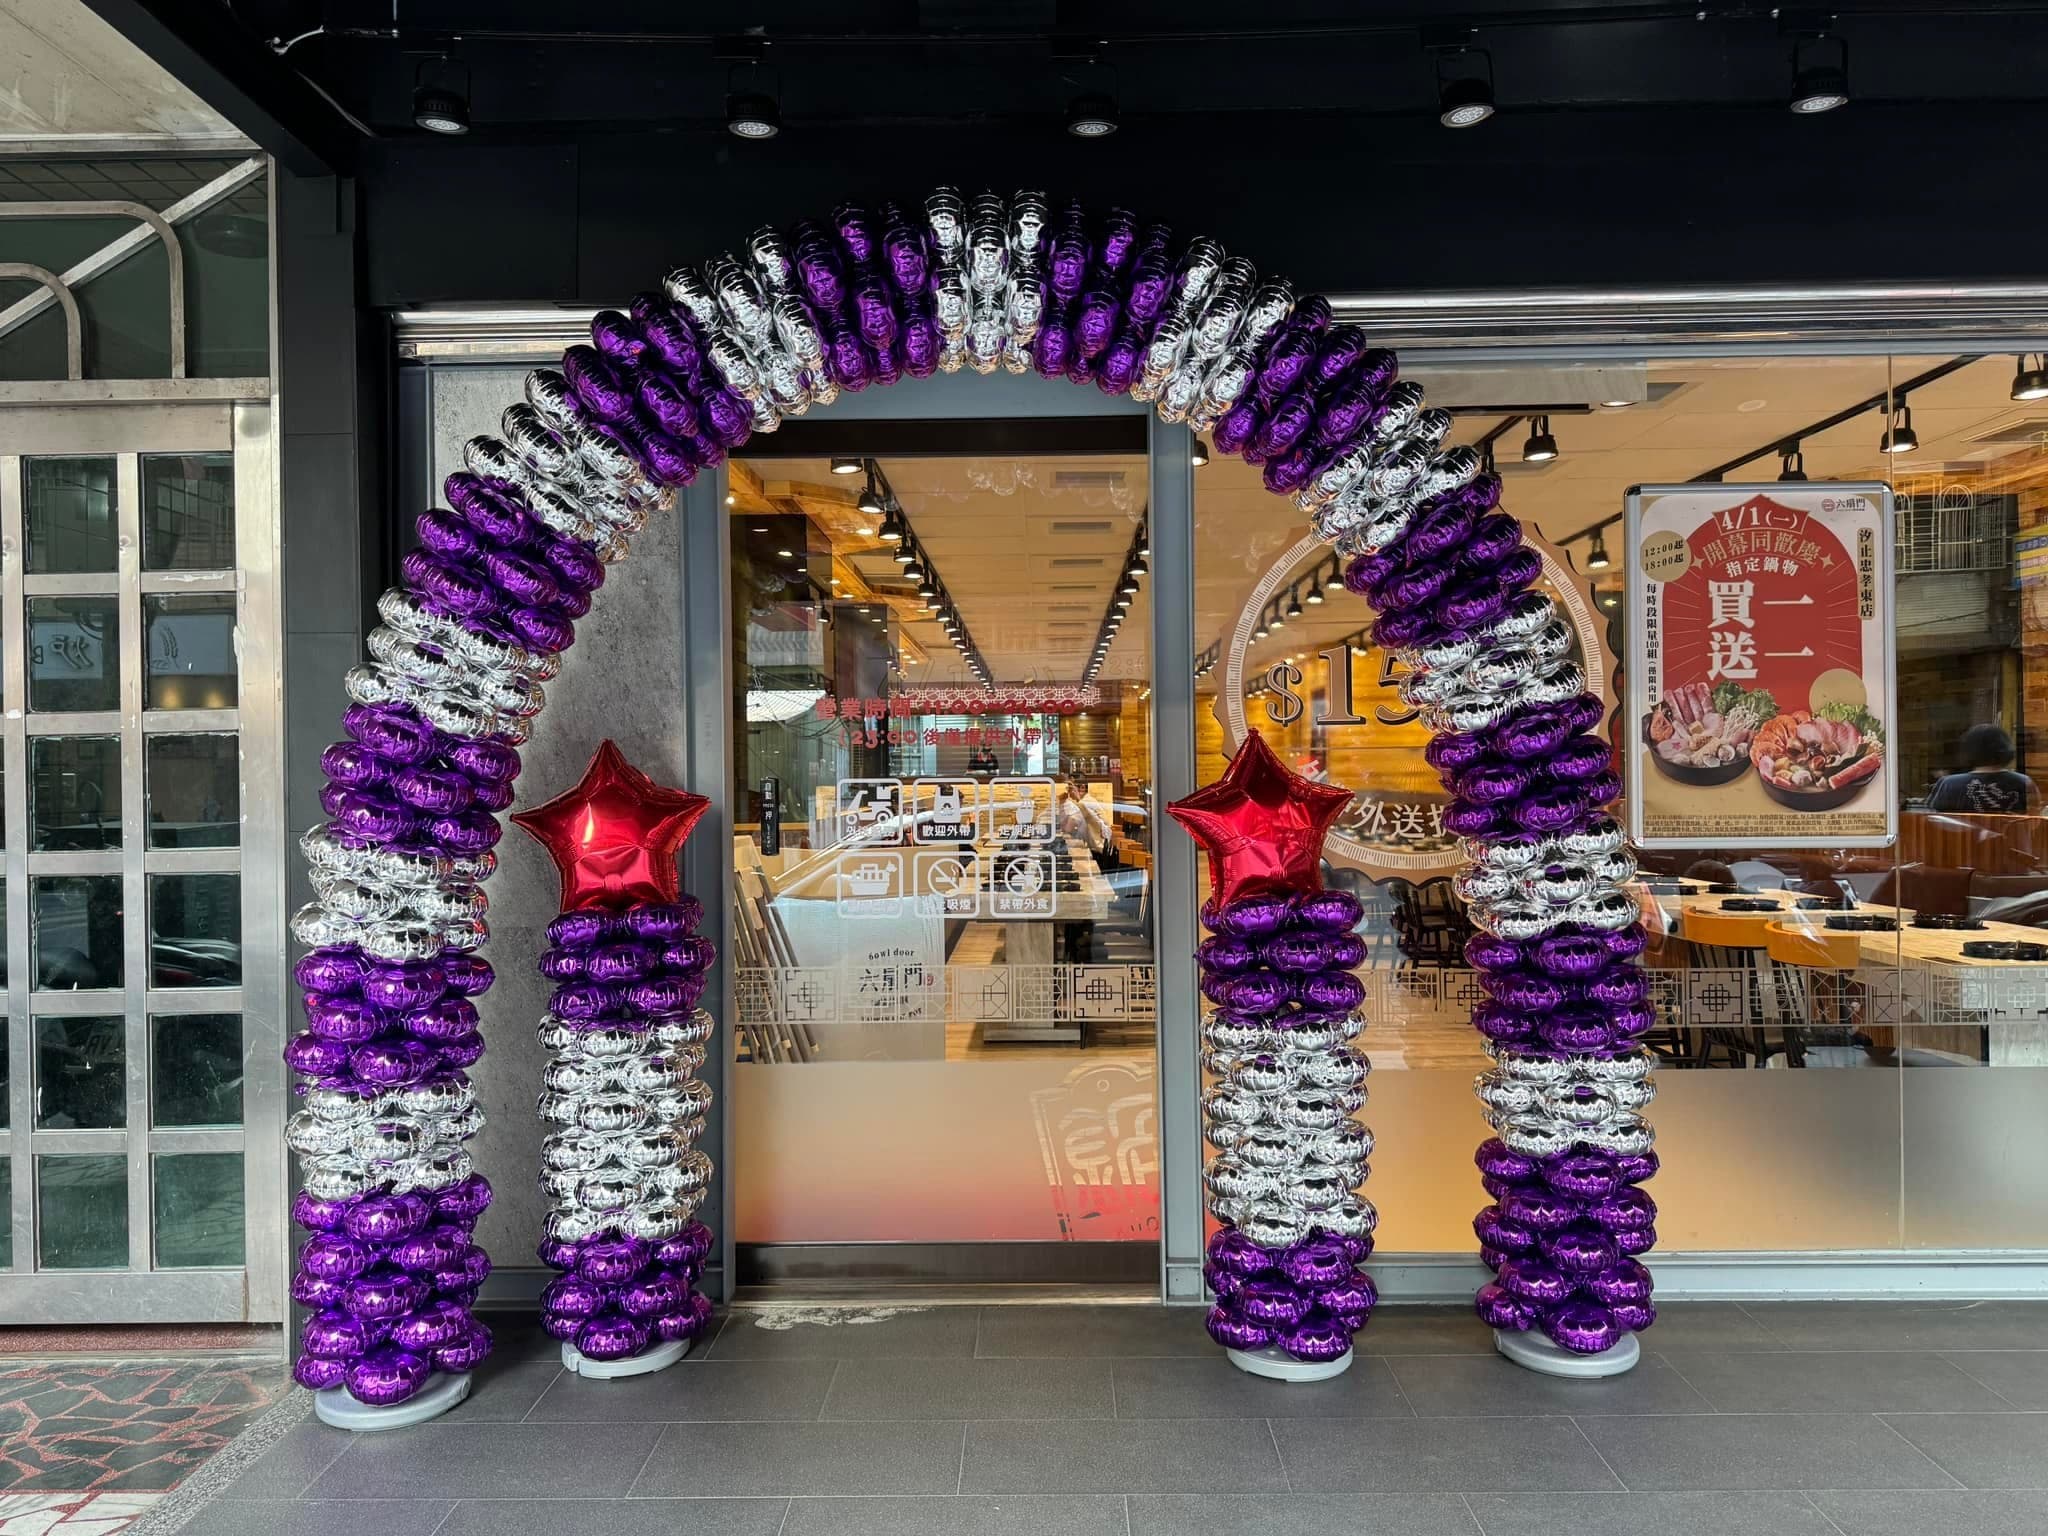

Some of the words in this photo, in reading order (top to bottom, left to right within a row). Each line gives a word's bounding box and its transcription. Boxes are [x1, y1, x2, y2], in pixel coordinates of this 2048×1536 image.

[1722, 506, 1798, 530] 4/1(一)
[1645, 539, 1684, 557] 12:00起
[1702, 530, 1821, 566] 開幕同歡慶
[1725, 556, 1799, 578] 指定鍋物
[1859, 529, 1873, 618] 汐止忠孝東店
[816, 697, 912, 721] 營業時間
[922, 824, 971, 838] 歡迎外帶
